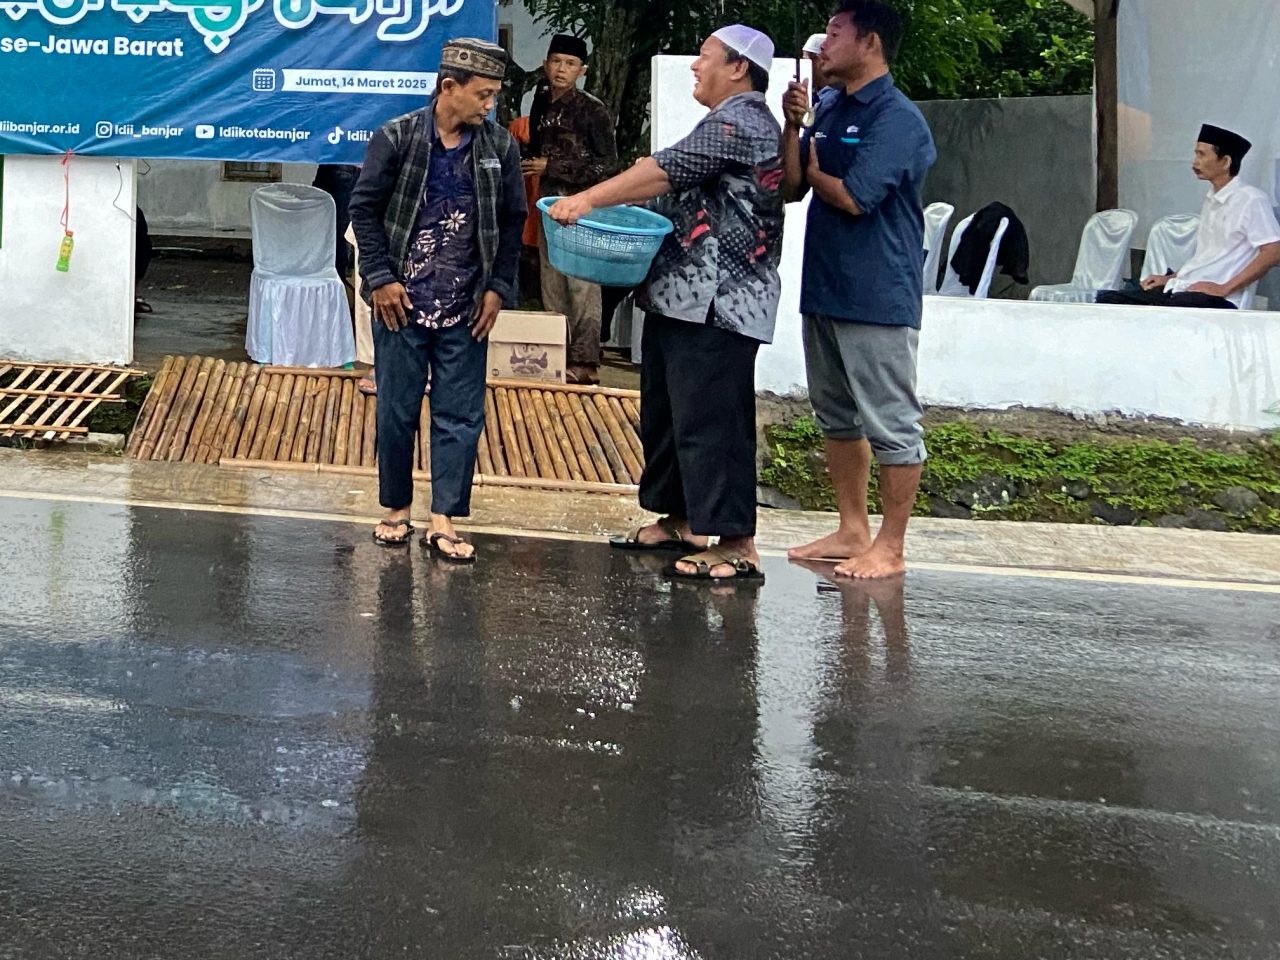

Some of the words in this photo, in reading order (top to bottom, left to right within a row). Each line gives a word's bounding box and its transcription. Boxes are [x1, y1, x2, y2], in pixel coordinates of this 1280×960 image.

[0, 35, 109, 55] se-Jawa
[114, 37, 183, 57] Barat
[295, 76, 340, 88] Jumat,
[342, 77, 355, 87] 14
[357, 77, 395, 89] Maret
[397, 79, 427, 89] 2025
[114, 124, 184, 139] ldii_banjar
[219, 126, 311, 142] ldiikotabanjar
